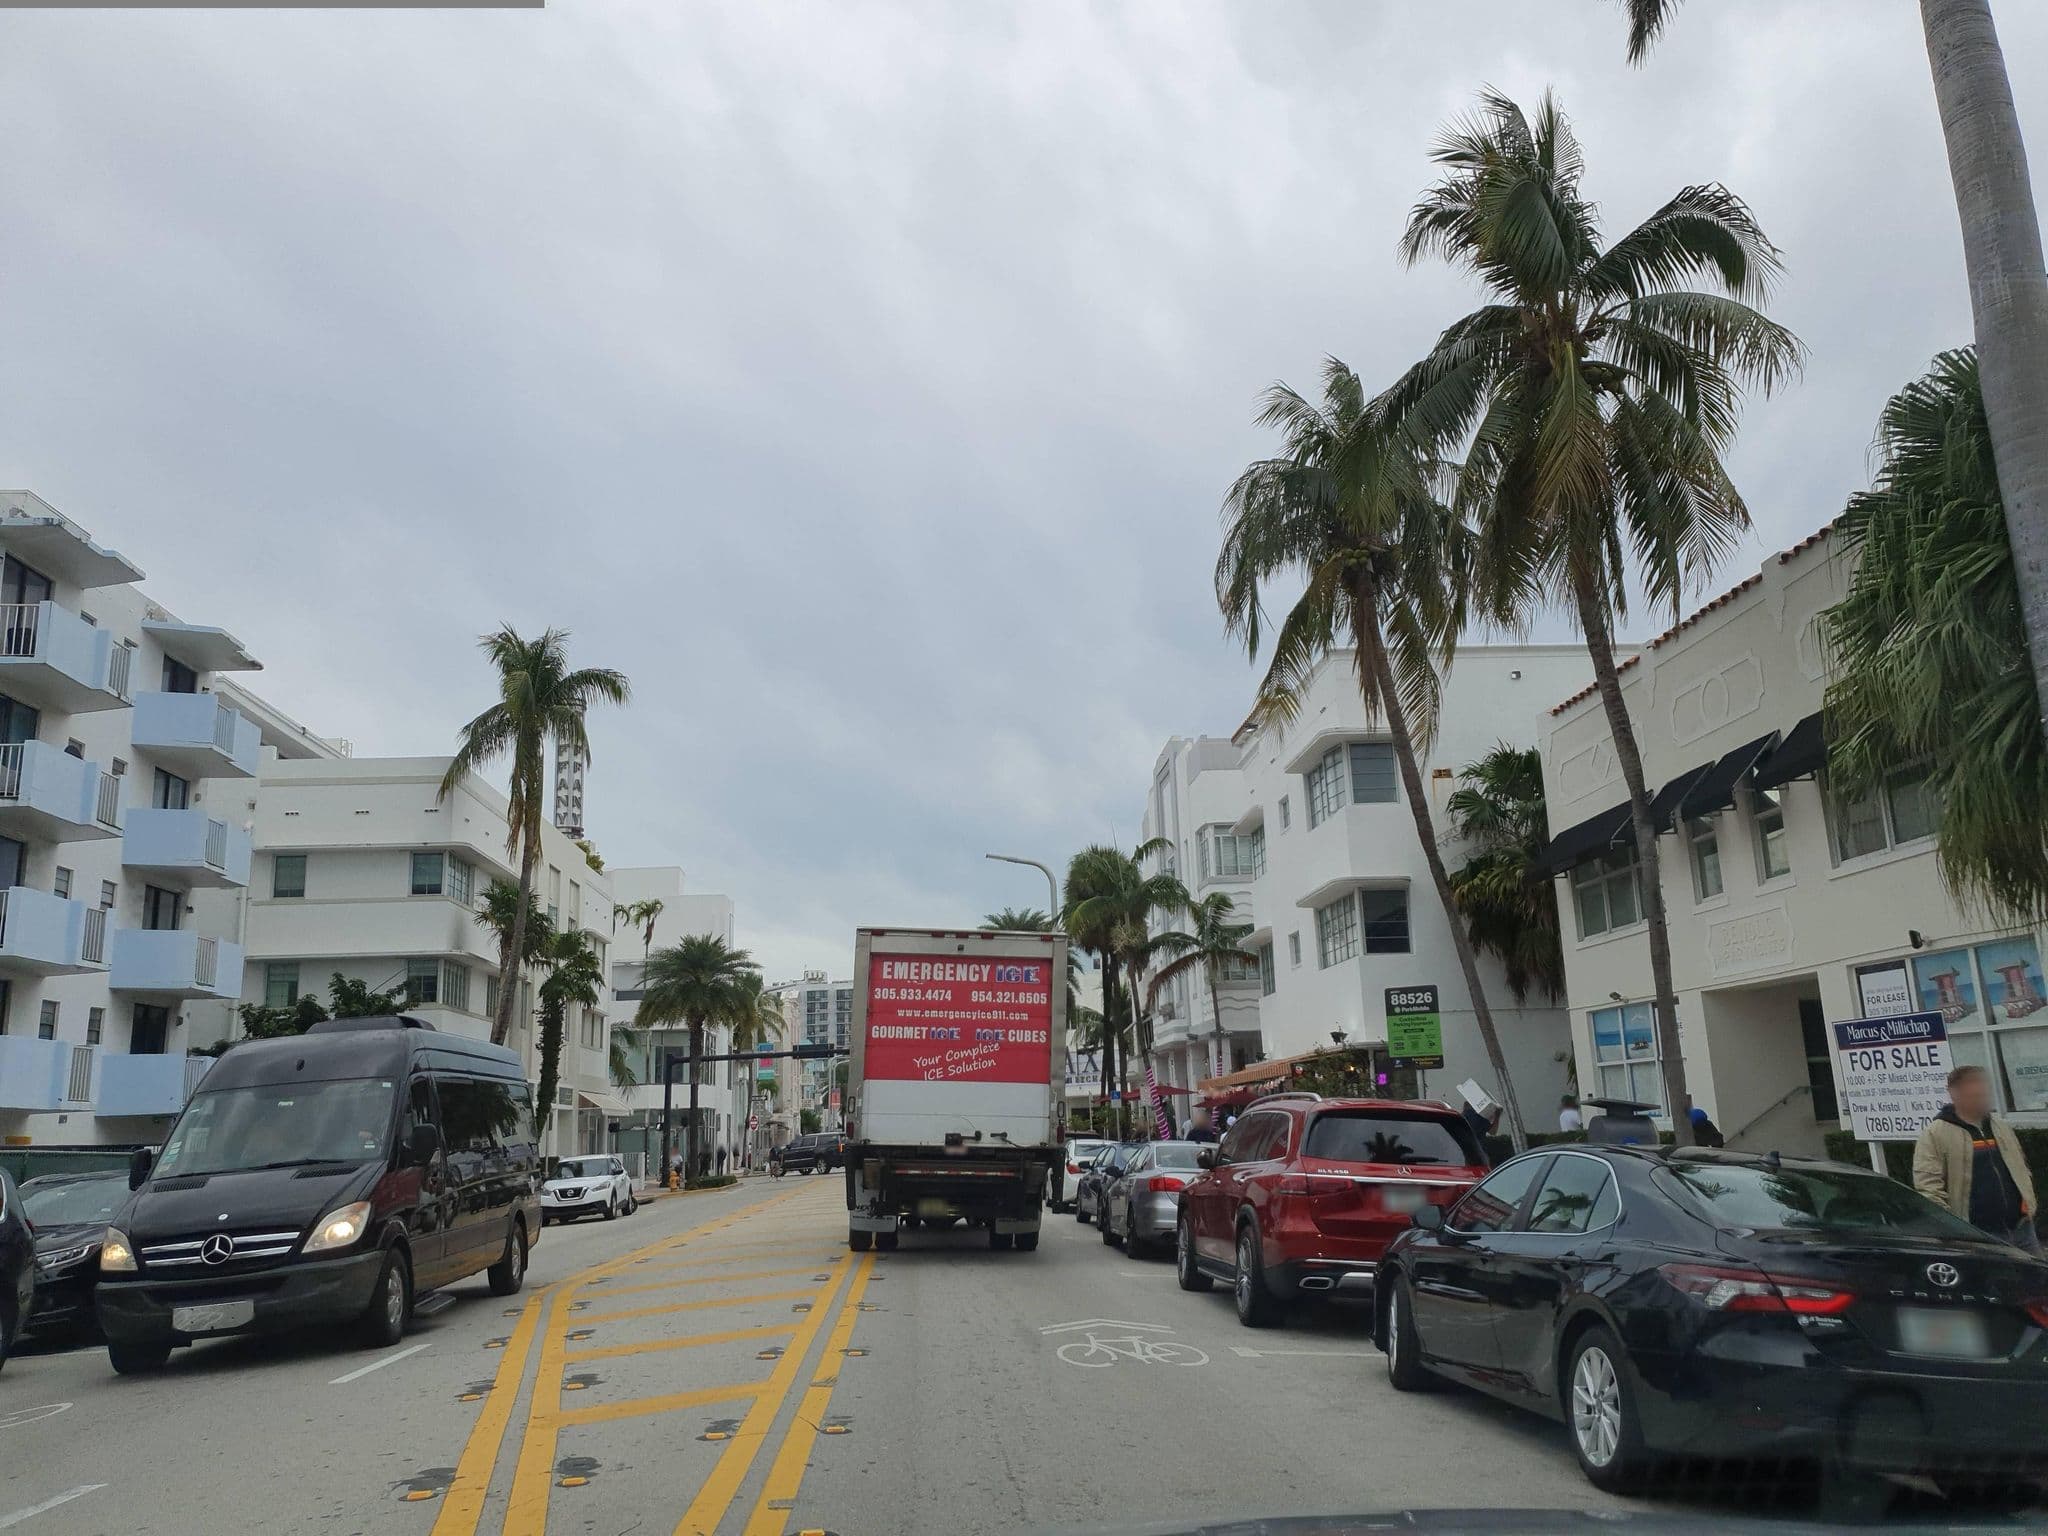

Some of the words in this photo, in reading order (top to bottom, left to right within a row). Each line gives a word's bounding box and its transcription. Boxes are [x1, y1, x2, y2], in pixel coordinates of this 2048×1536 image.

[882, 961, 991, 982] EMERGENCY
[995, 964, 1041, 984] ICE
[874, 987, 952, 1001] 305.933.4474
[1390, 992, 1433, 1006] 88526
[1866, 995, 1882, 1005] FOR
[1882, 992, 1906, 1003] LEASE
[896, 1008, 1029, 1021] www.emergencyice911.com
[871, 1025, 929, 1040] GOURMET
[929, 1026, 961, 1041] ICE
[975, 1028, 1006, 1041] ICE
[1008, 1029, 1047, 1043] CUBES
[1846, 1025, 1880, 1041] Marcus
[1879, 1026, 1891, 1041] &
[1886, 1019, 1930, 1036] Millichap
[912, 1055, 942, 1069] Your
[945, 1041, 1000, 1062] Complete
[1849, 1049, 1887, 1072] FOR
[1891, 1044, 1941, 1068] SALE
[924, 1067, 944, 1081] ICE
[947, 1058, 997, 1077] Solution
[1909, 1072, 1922, 1082] Use
[1852, 1103, 1868, 1113] Drew
[1865, 1116, 1894, 1133] (786)
